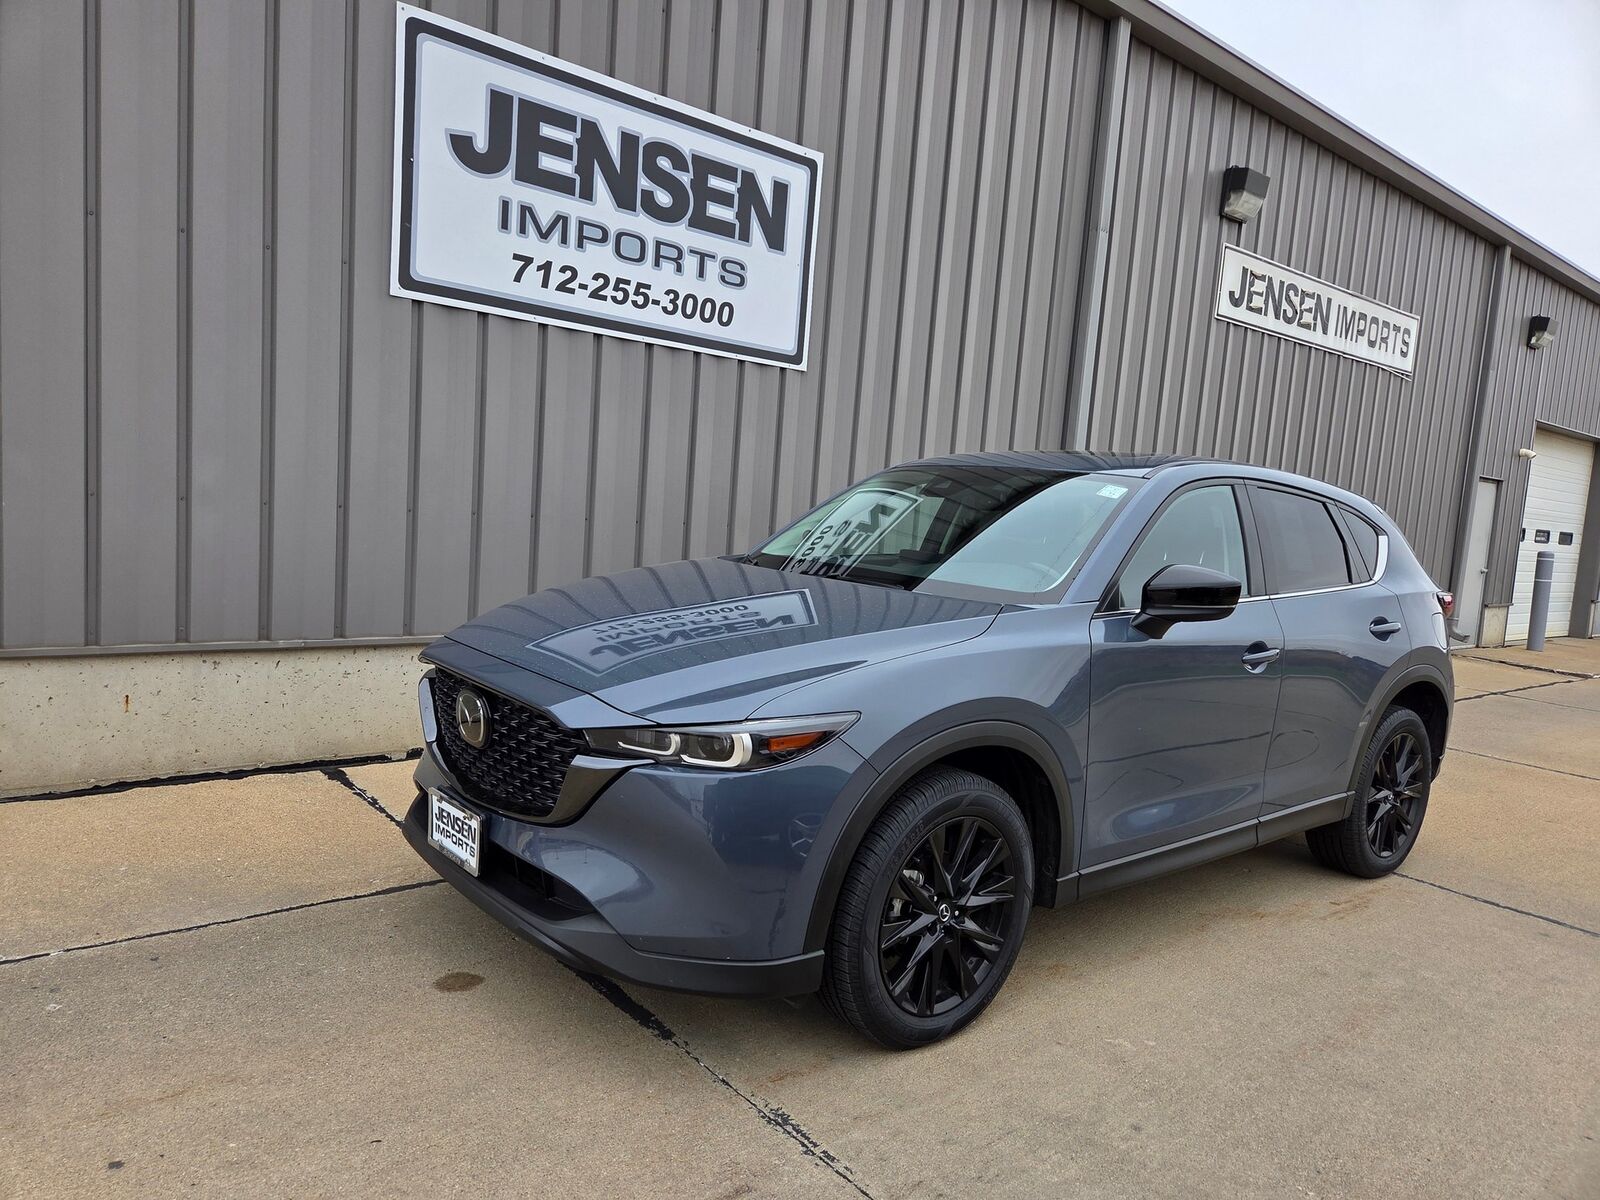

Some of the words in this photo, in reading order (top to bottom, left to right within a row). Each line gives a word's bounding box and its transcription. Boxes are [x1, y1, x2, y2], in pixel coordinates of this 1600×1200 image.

[446, 85, 789, 254] JENSEN
[498, 198, 748, 288] IMPORTS
[512, 253, 735, 327] 712-255-3000
[1228, 265, 1332, 335] JENSEN
[1334, 303, 1412, 358] IMPORTS
[435, 806, 476, 845] JENSEN
[435, 822, 475, 858] IMPORTS
